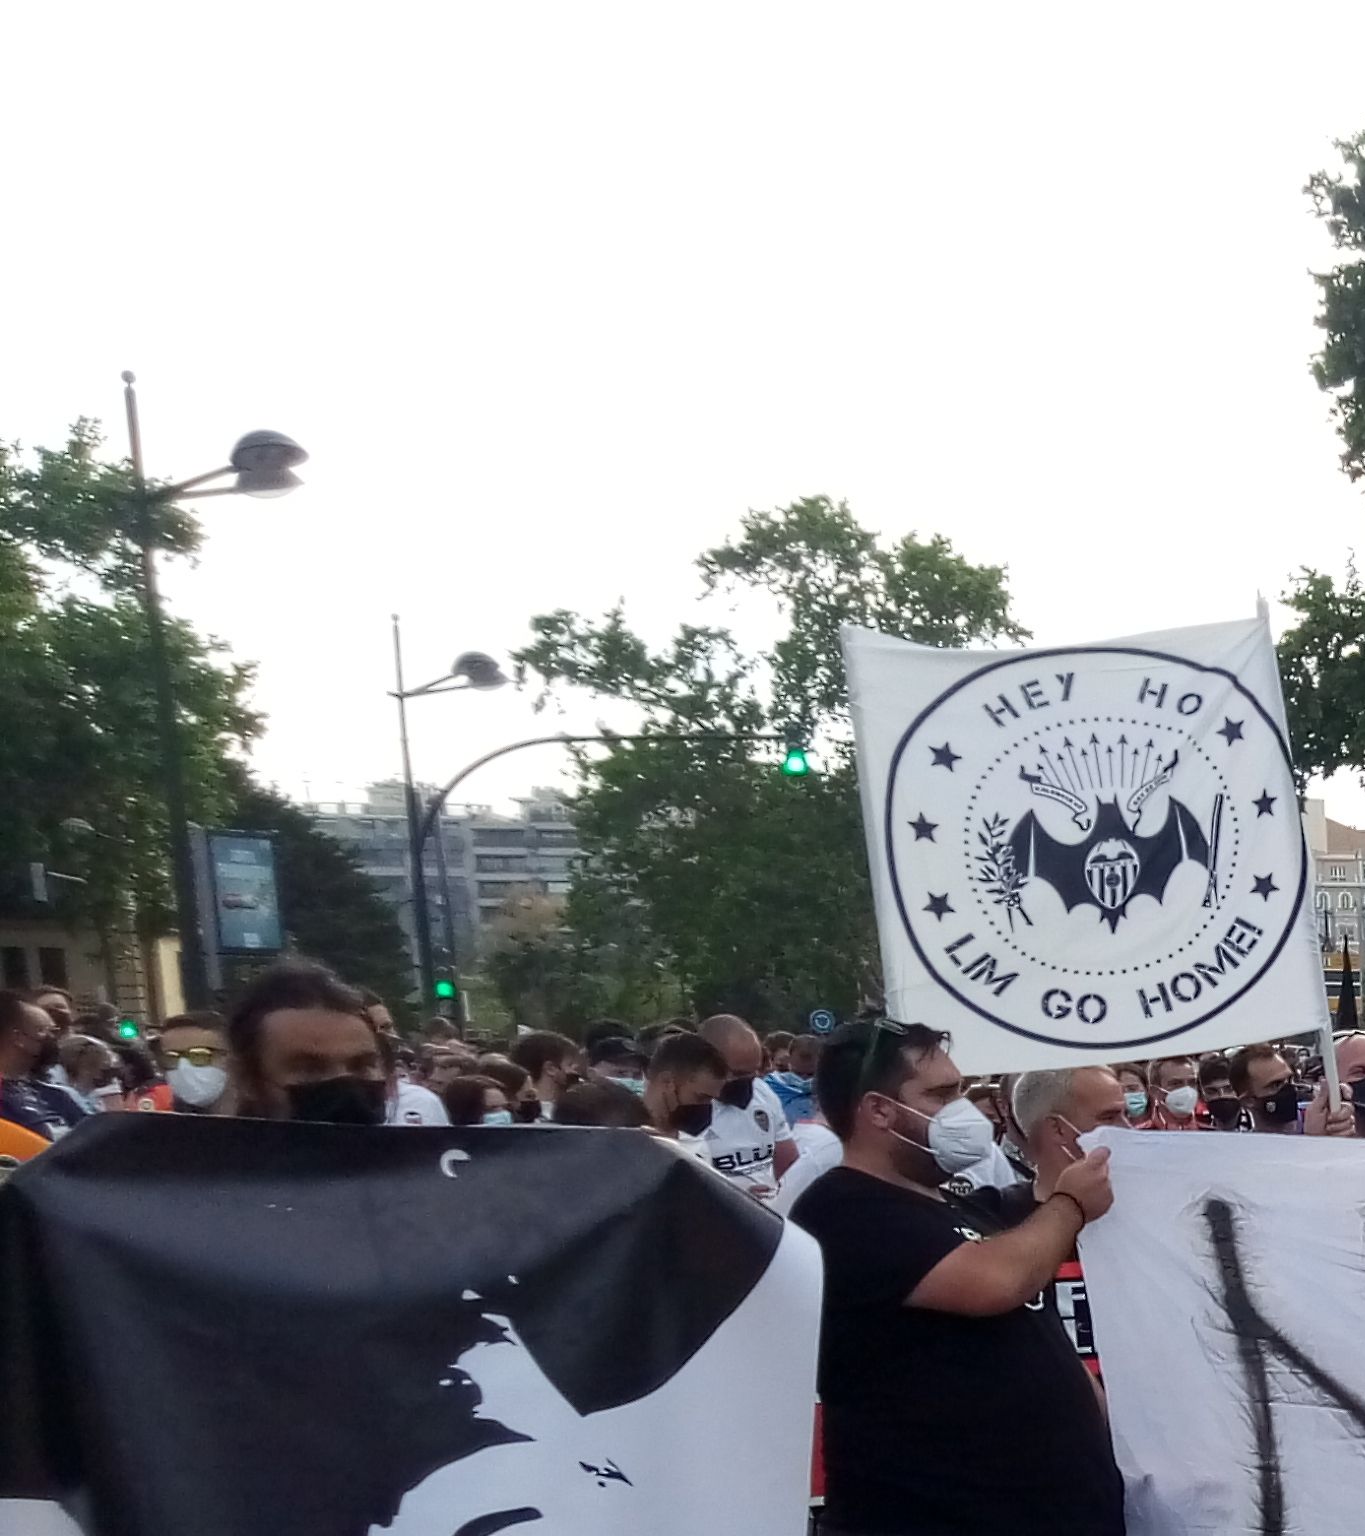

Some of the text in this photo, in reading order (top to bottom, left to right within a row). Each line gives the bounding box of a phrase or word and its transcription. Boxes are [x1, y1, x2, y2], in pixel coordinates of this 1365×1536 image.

[981, 672, 1202, 727] HEY HO
[943, 916, 1264, 1025] LIM GO HOME!
